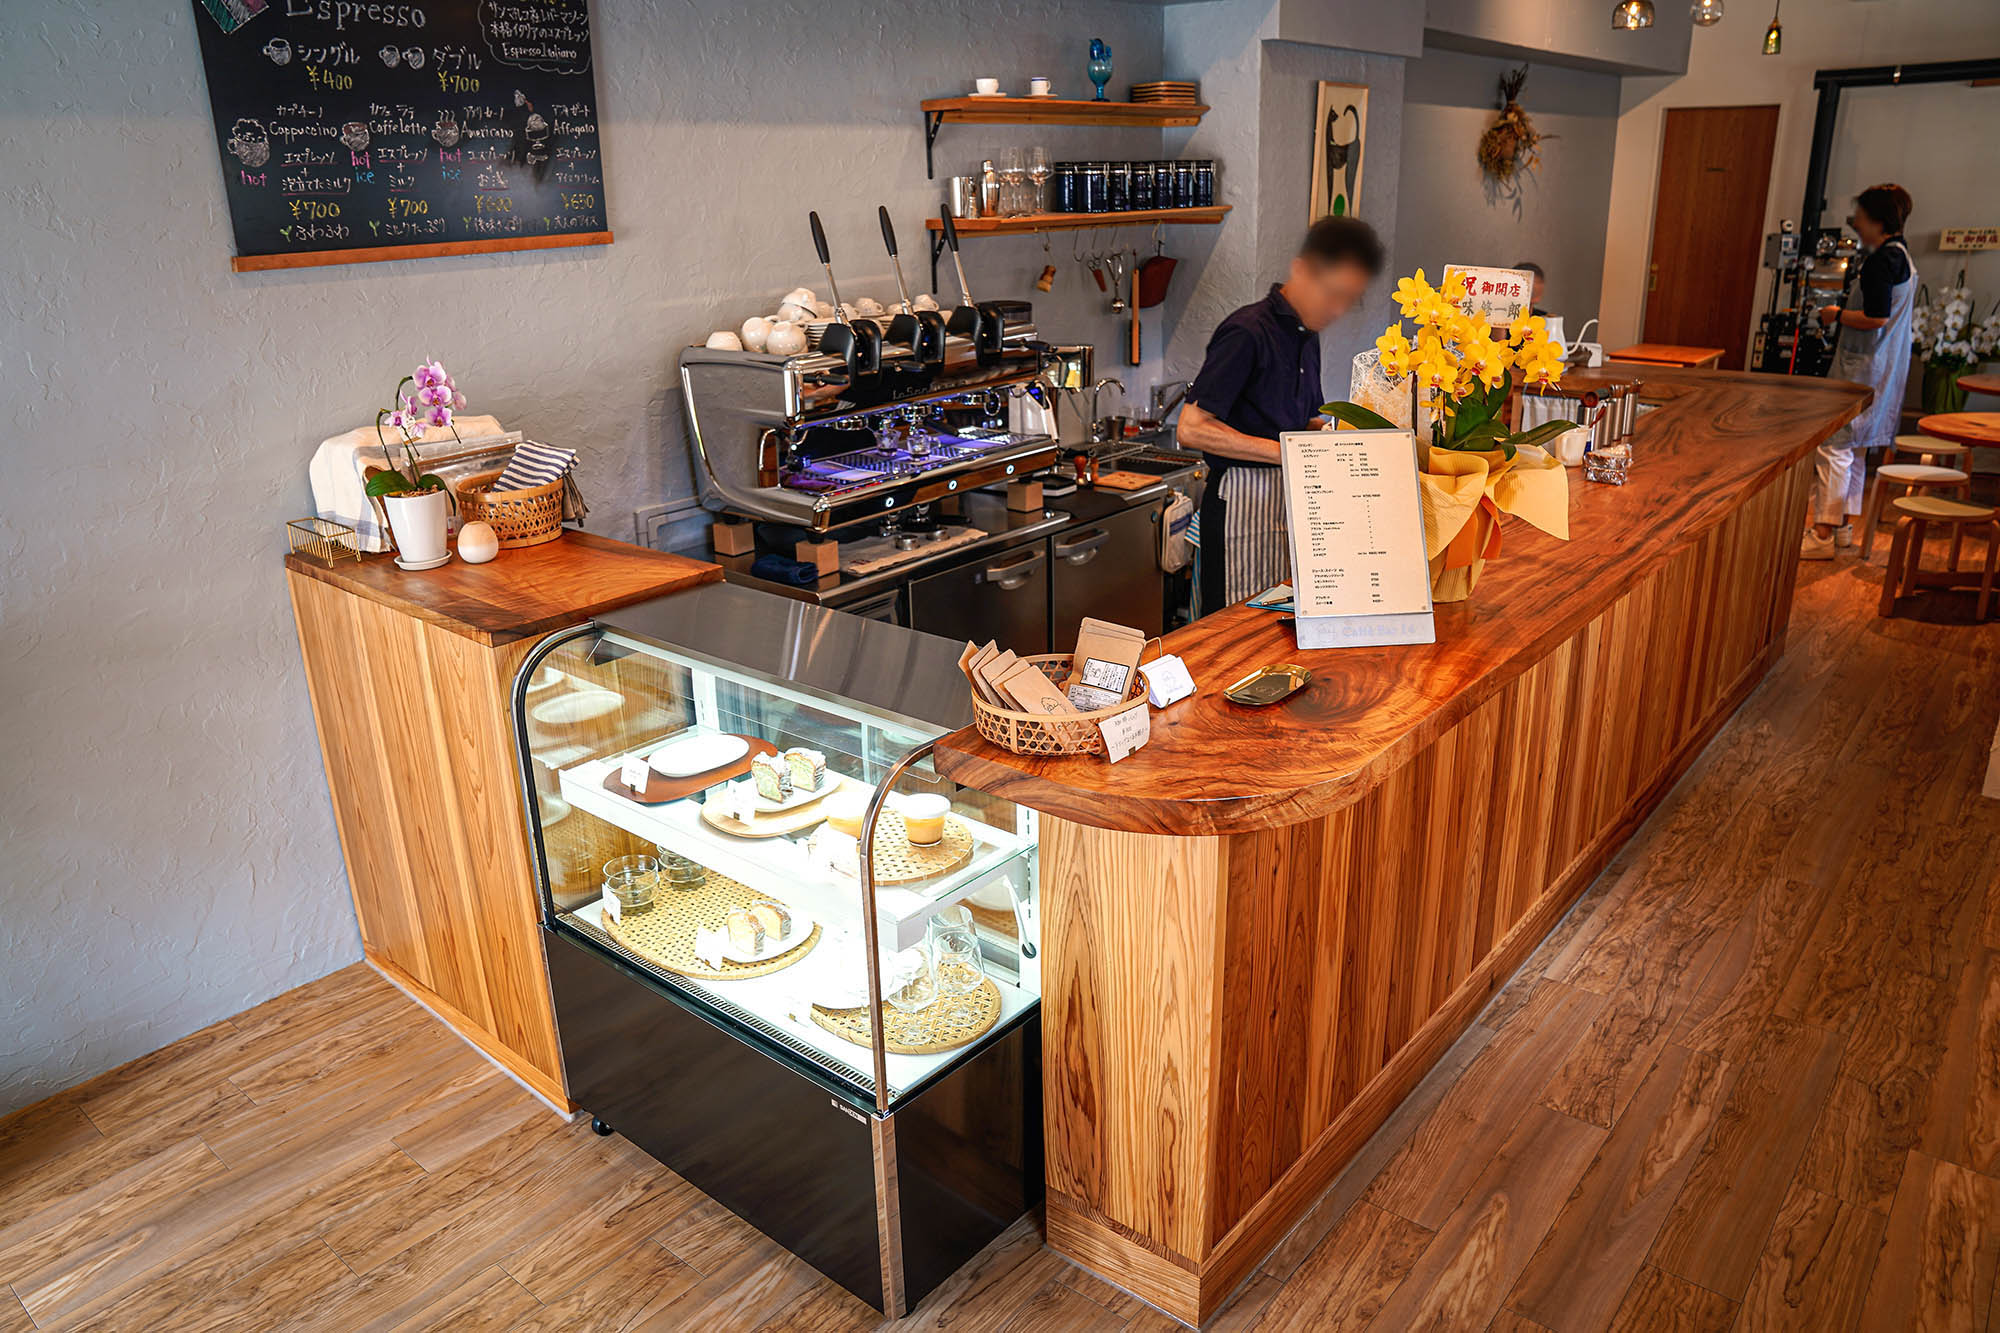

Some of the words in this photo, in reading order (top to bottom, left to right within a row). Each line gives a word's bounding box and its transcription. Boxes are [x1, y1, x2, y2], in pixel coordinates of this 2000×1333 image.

[298, 41, 361, 66] シングル
[433, 45, 482, 71] ダブル
[306, 65, 353, 90] ¥400
[438, 71, 480, 93] ¥700
[269, 121, 338, 144] Cappuccino
[460, 120, 514, 139] Americano
[553, 119, 595, 139] Affogato
[284, 148, 336, 164] エスプレッソ
[351, 151, 371, 169] hot
[377, 144, 428, 162] エスプレッソ
[440, 147, 462, 163] hot
[241, 170, 267, 187] hot
[355, 166, 376, 184] ice
[388, 174, 415, 188] ミルク
[441, 165, 462, 183] ice
[282, 176, 351, 193] 泡立てたミルク
[289, 200, 341, 220] ¥700
[387, 197, 428, 219] ¥700
[295, 224, 350, 241] ふわふわ
